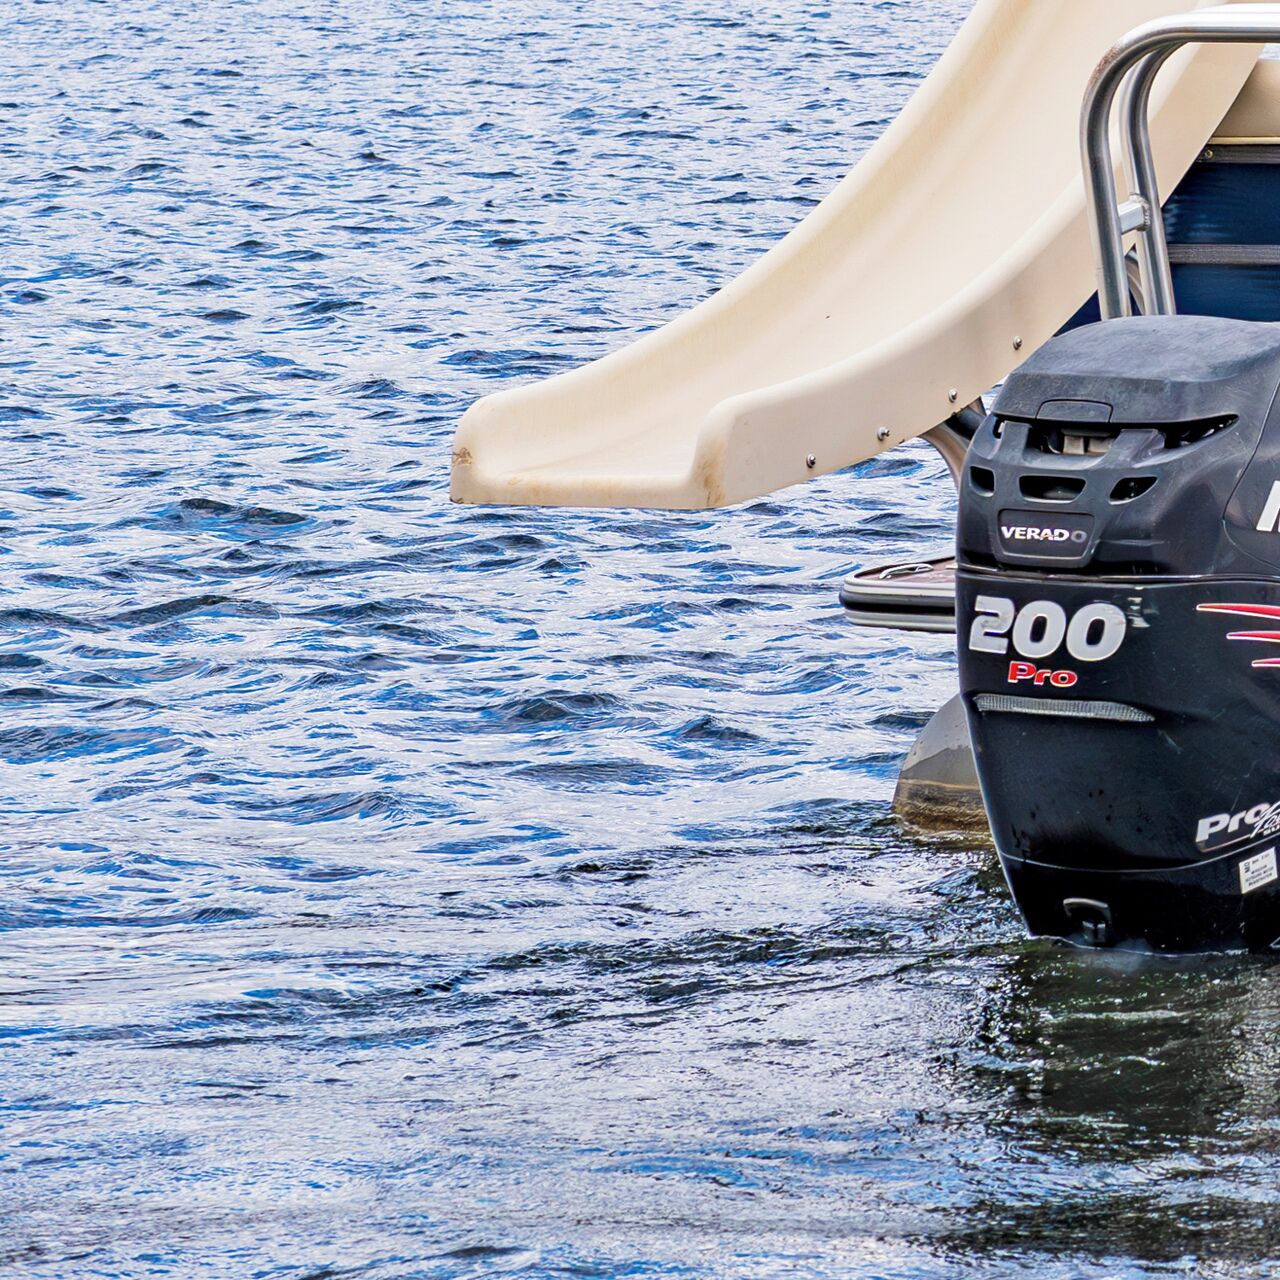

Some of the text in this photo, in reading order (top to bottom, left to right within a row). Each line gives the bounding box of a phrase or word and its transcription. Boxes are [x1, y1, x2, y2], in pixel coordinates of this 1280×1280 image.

[1000, 526, 1087, 543] VERADO
[969, 594, 1127, 661] 200
[1007, 660, 1078, 687] Pro
[1195, 802, 1271, 843] Pro
